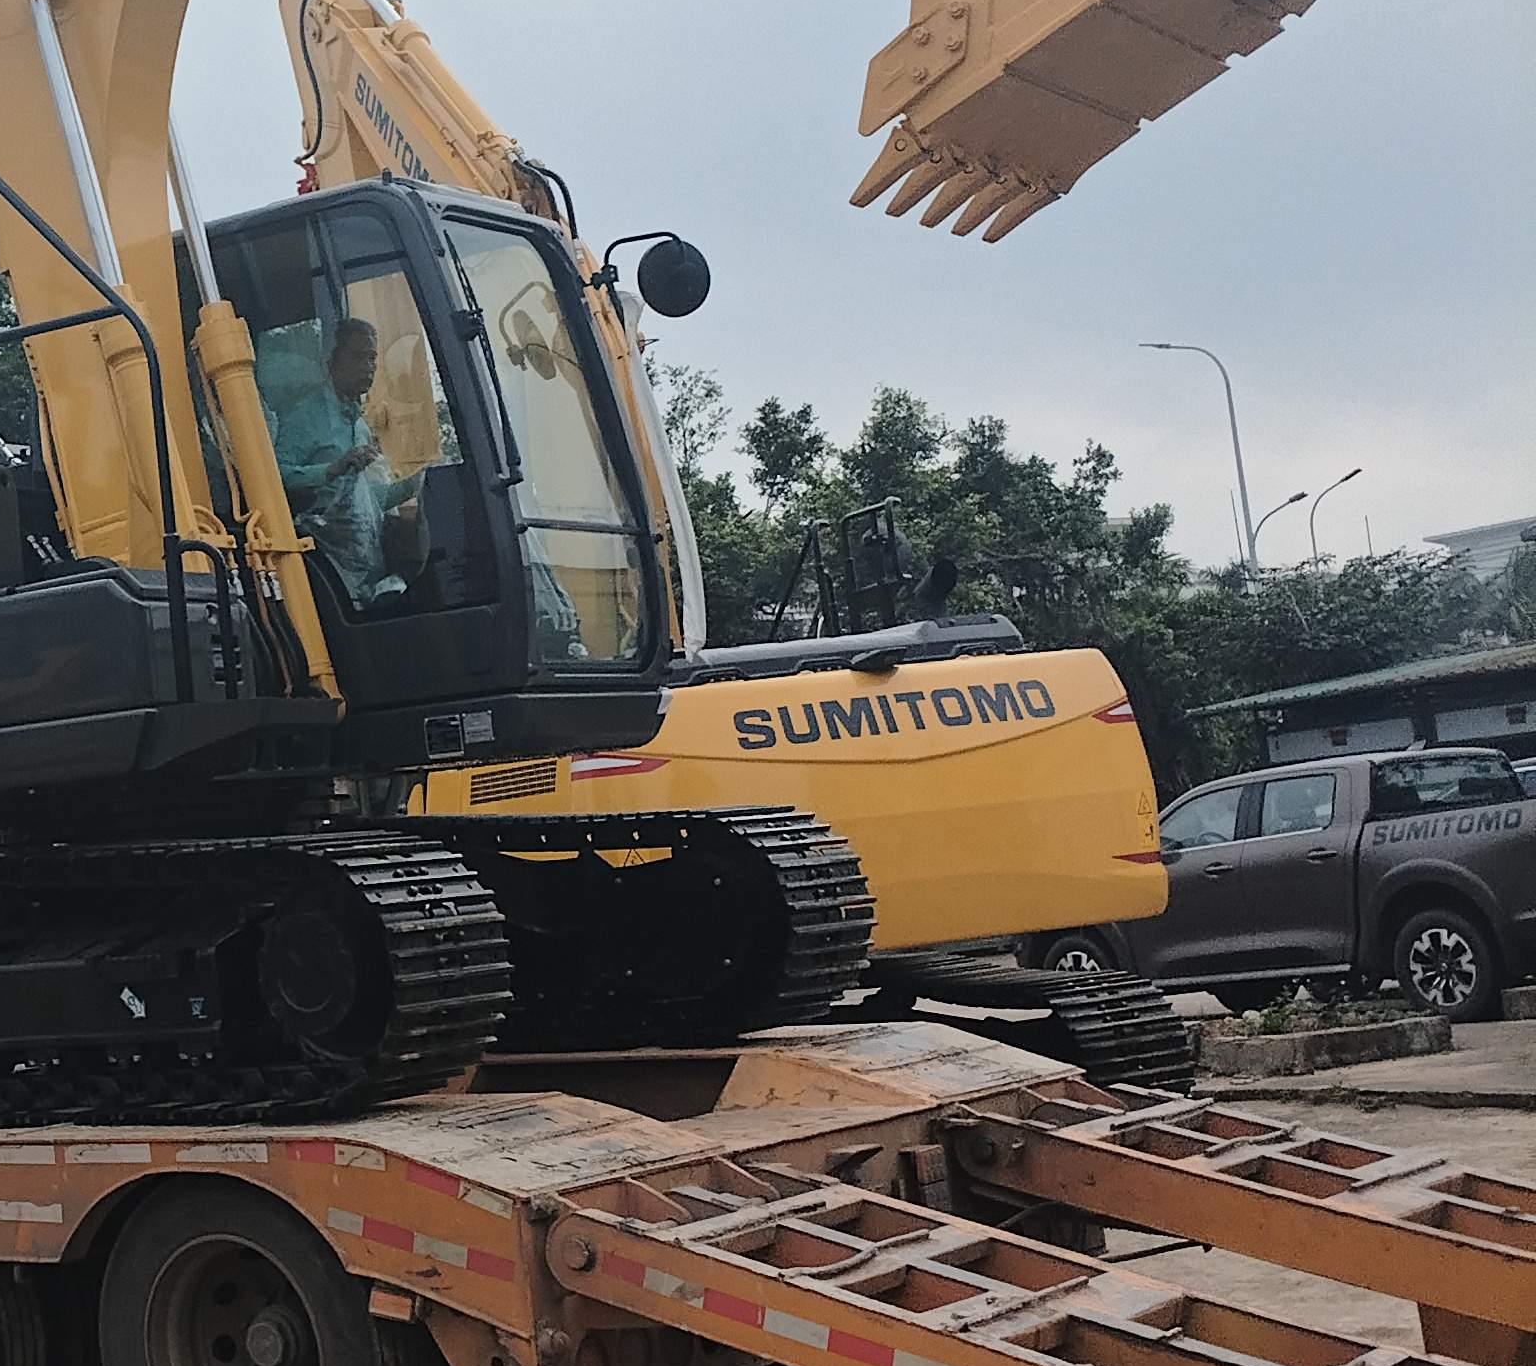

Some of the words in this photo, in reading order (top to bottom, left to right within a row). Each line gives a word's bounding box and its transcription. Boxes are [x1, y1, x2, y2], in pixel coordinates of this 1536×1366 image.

[355, 74, 436, 184] SUMITOM
[733, 679, 1056, 750] SUMITOMO
[1372, 808, 1523, 846] SUMITOMO
